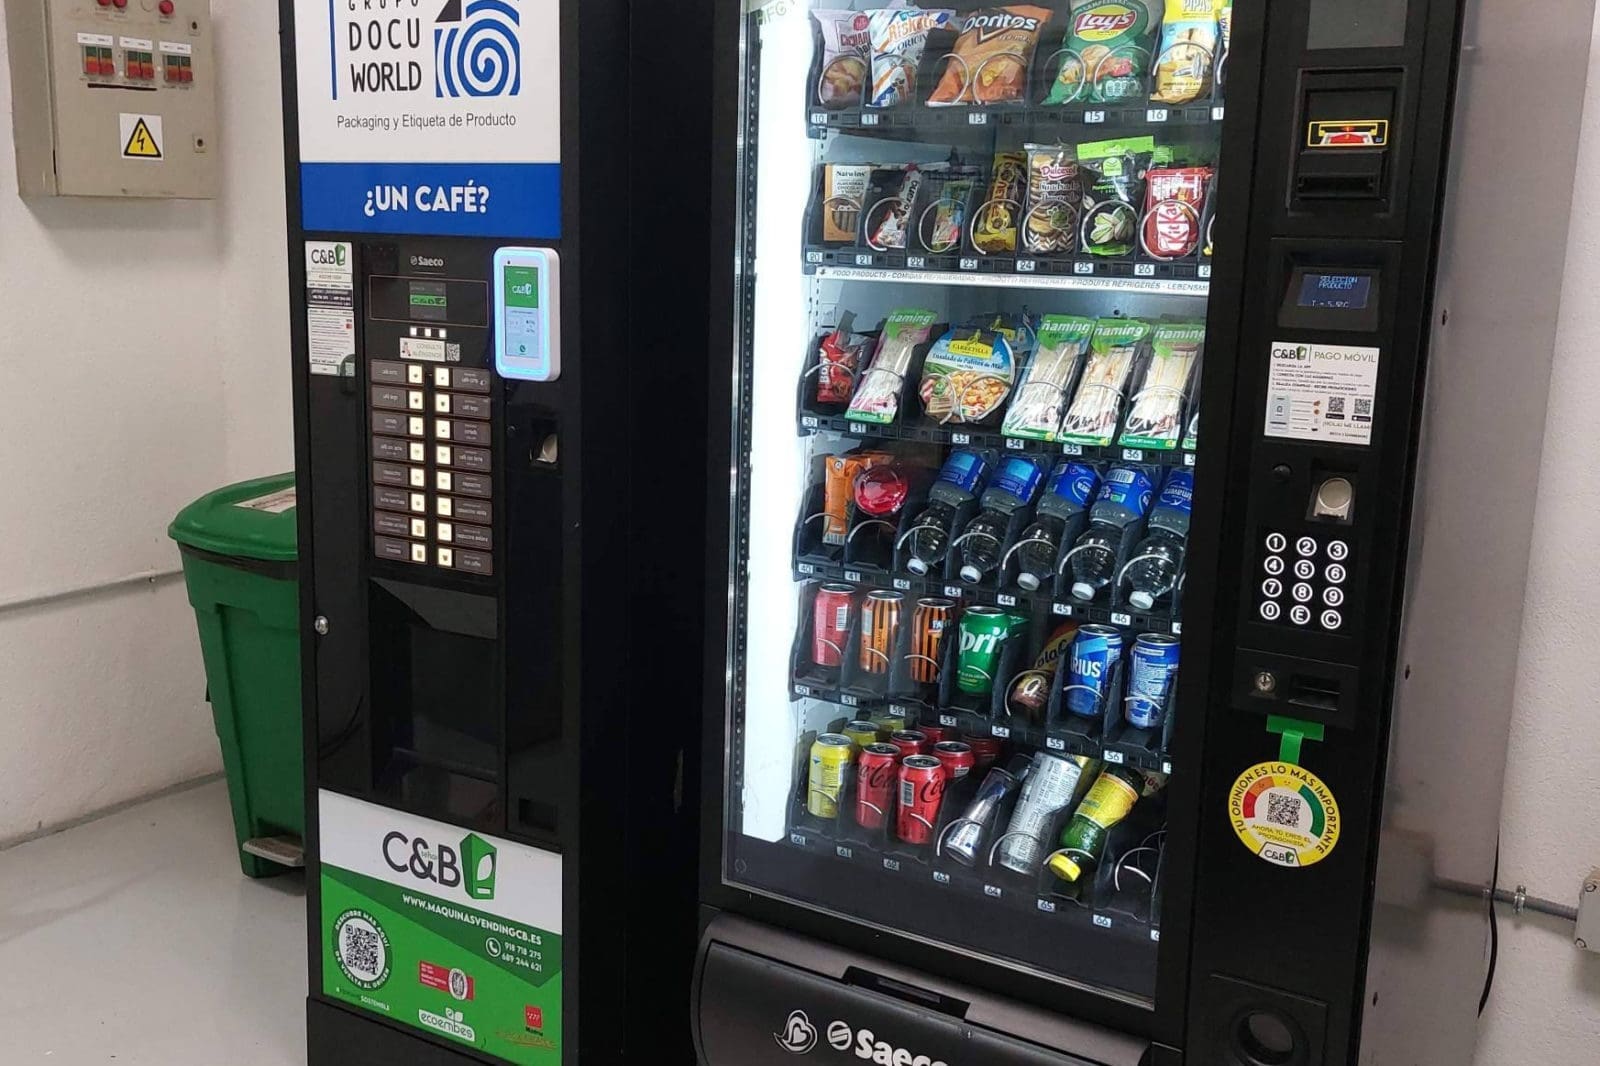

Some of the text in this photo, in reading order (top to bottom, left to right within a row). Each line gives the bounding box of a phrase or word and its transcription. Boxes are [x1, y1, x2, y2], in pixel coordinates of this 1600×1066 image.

[349, 18, 420, 51] DOCU
[962, 14, 1038, 34] Doritos
[350, 61, 422, 93] WORLD
[337, 112, 517, 131] Packaging y Etiqueta de Producto
[363, 179, 490, 217] ¿UN CAFÉ?
[311, 249, 336, 264] C&B
[418, 255, 444, 267] Saeco
[852, 271, 887, 279] PRODUCTS
[1272, 348, 1376, 363] C&B PAGO MÓVIL
[1235, 820, 1247, 834] TU
[1254, 766, 1268, 777] ES
[1270, 765, 1286, 774] LO
[1290, 768, 1316, 787] MÁS
[1314, 786, 1337, 855] IMPORTANTE
[382, 830, 460, 888] C&B
[1264, 849, 1285, 862] C&B
[402, 893, 542, 946] WWW.MAQUINASVENDINGCB.ES
[504, 942, 542, 961] 918 718 275
[502, 952, 542, 973] 689 244 621
[421, 1012, 473, 1040] ecoembes
[855, 1029, 948, 1066] Sae
